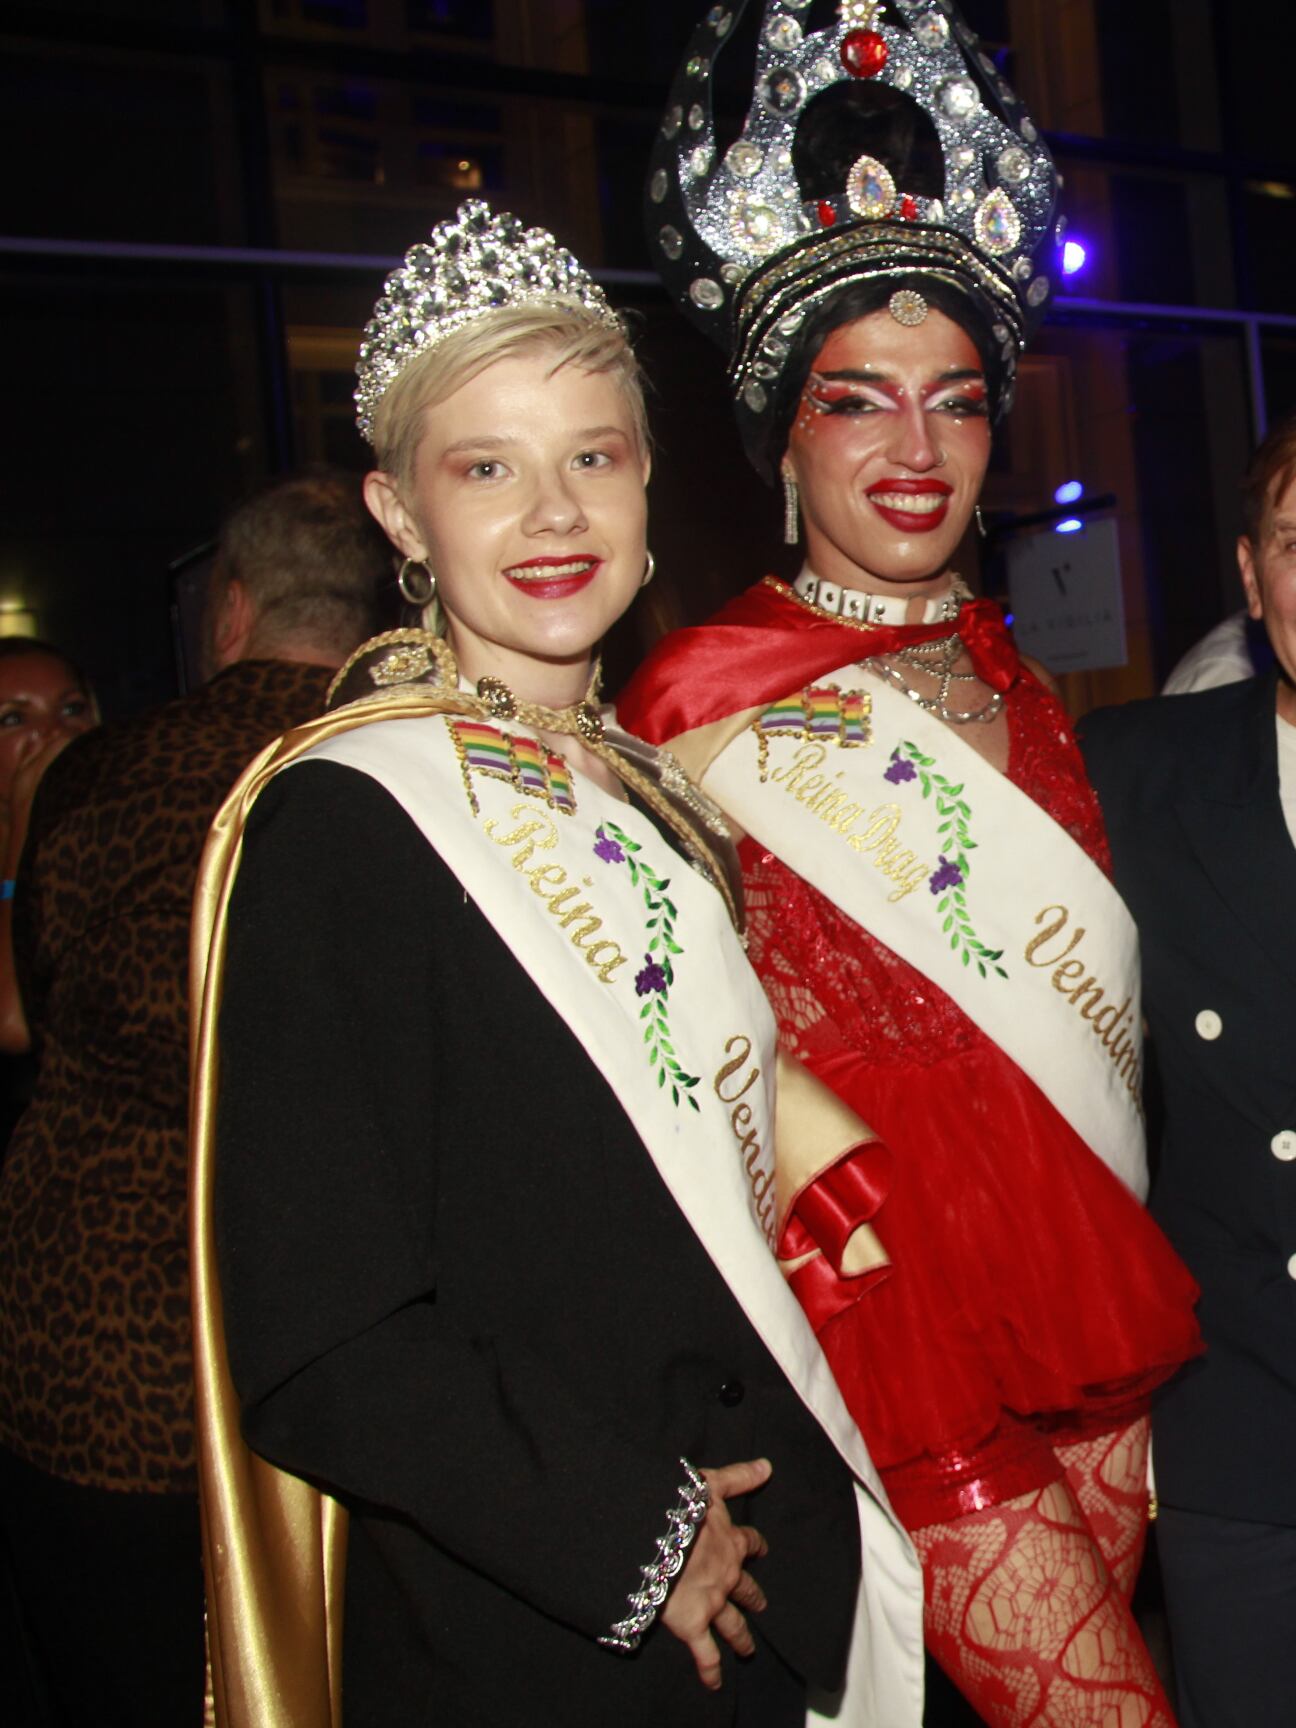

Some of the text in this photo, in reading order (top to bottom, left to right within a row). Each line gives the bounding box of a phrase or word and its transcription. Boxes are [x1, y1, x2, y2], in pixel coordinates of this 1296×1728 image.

[483, 803, 628, 984] Reina
[771, 743, 931, 903] Reina Drag
